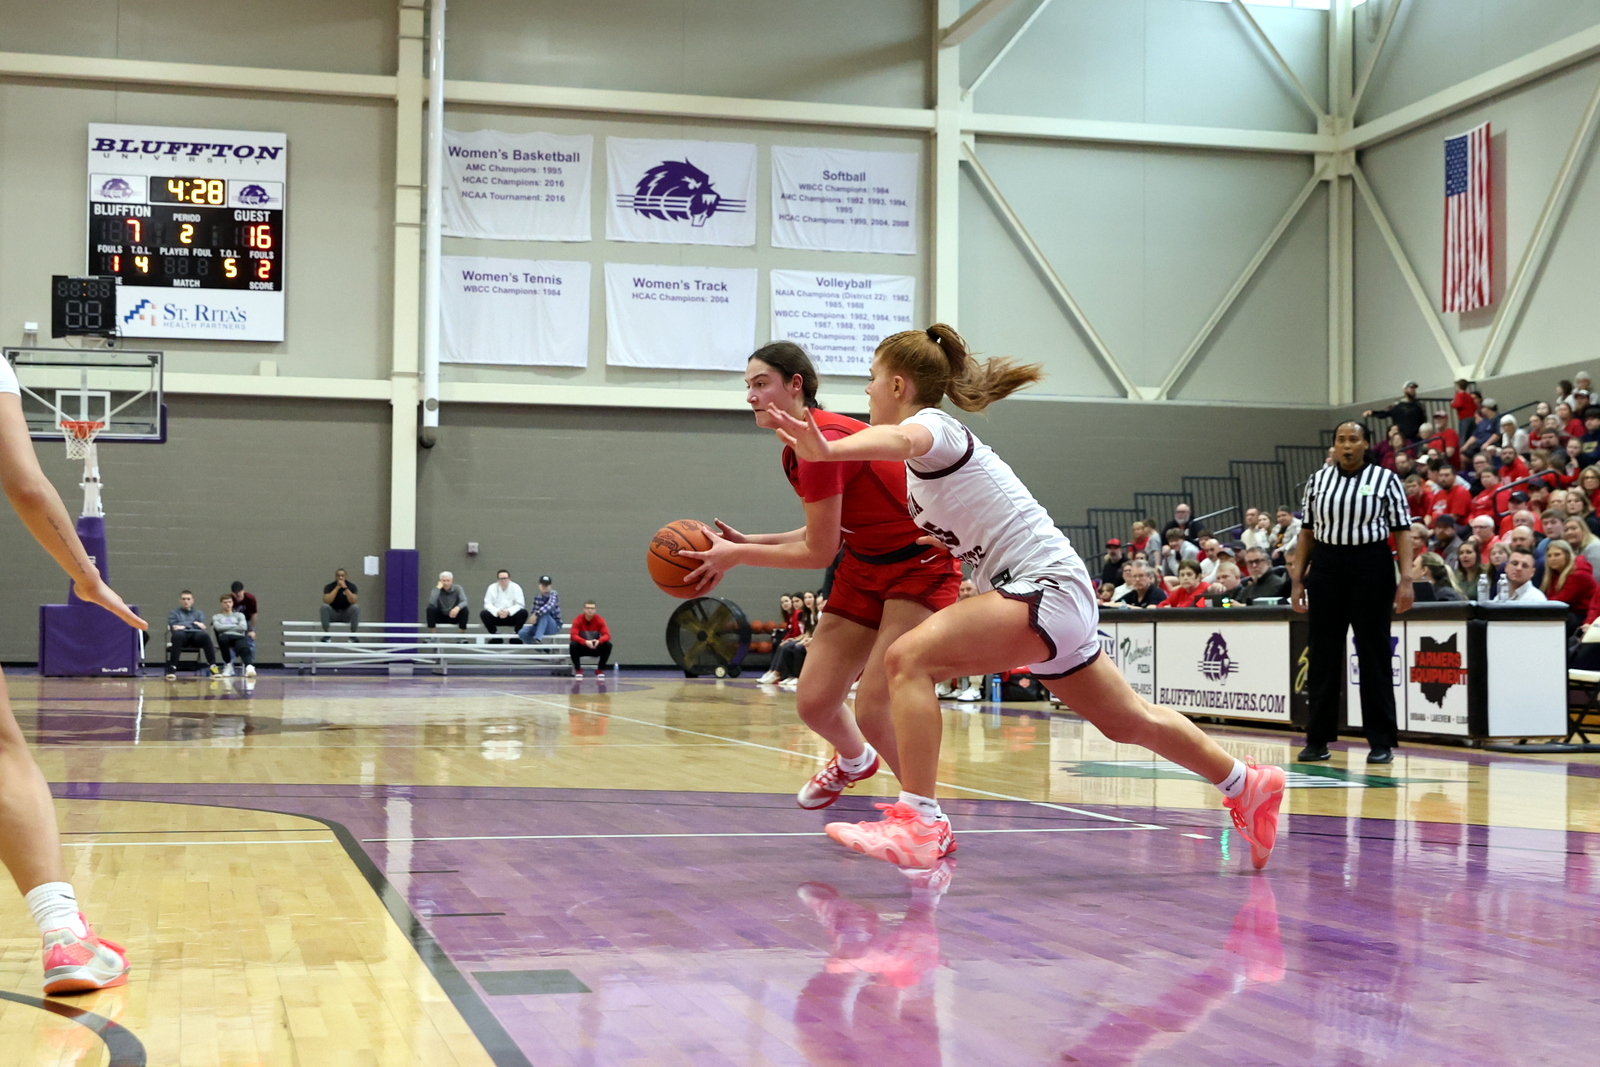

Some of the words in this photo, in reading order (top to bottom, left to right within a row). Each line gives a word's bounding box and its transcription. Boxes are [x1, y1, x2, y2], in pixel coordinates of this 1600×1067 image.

[92, 138, 283, 160] BLUFFTON
[448, 146, 508, 160] Women's
[513, 150, 580, 162] Basketball
[103, 153, 261, 165] UNIVERSITY
[466, 164, 486, 172] AMC
[488, 164, 540, 174] Champions:
[462, 176, 489, 184] HCAC
[491, 177, 542, 187] Champions:
[822, 170, 866, 182] Softball
[167, 179, 224, 205] 4:28
[798, 184, 823, 192] WBCC
[462, 191, 487, 200] NCAA
[490, 192, 542, 202] Tournament:
[94, 204, 152, 217] BLUFFTON
[234, 210, 270, 222] GUEST
[172, 213, 200, 222] PERIOD
[126, 219, 141, 242] 7
[179, 224, 194, 244] 2
[249, 225, 272, 248] 16
[98, 244, 123, 254] FOULS
[130, 246, 152, 254] T.O.L.
[160, 247, 189, 256] PLAYER
[192, 248, 212, 257] FOUL
[220, 250, 241, 258] T.O.L.
[249, 250, 274, 260] FOULS
[113, 256, 120, 272] 1
[134, 256, 149, 274] 4
[224, 258, 238, 278] 5
[258, 260, 272, 278] 2
[173, 278, 200, 288] MATCH
[462, 270, 518, 282] Women's
[522, 272, 562, 285] Tennis
[816, 277, 872, 290] Volleyball
[249, 281, 274, 290] SCORE
[463, 285, 490, 293] WBCC
[492, 286, 540, 296] Champions:
[633, 278, 690, 290] Women's
[694, 280, 728, 292] Track
[632, 292, 656, 300] HCAC
[658, 294, 708, 302] Champions:
[796, 290, 840, 299] Champions
[842, 292, 872, 300] (District
[163, 303, 188, 322] ST.
[196, 304, 247, 323] RITA'S
[774, 310, 800, 318] WBCC
[802, 311, 848, 320] Champions:
[164, 322, 198, 330] HEALTH
[787, 331, 811, 339] HCAC
[812, 332, 859, 342] Champions:
[811, 343, 858, 352] Tournament:
[825, 354, 844, 363] 2013,
[846, 356, 866, 364] 2014,
[1414, 651, 1462, 668] FARMERS
[1410, 667, 1468, 685] EQUIPMENT
[1159, 688, 1286, 714] BLUFFTONBEAVERS.COM
